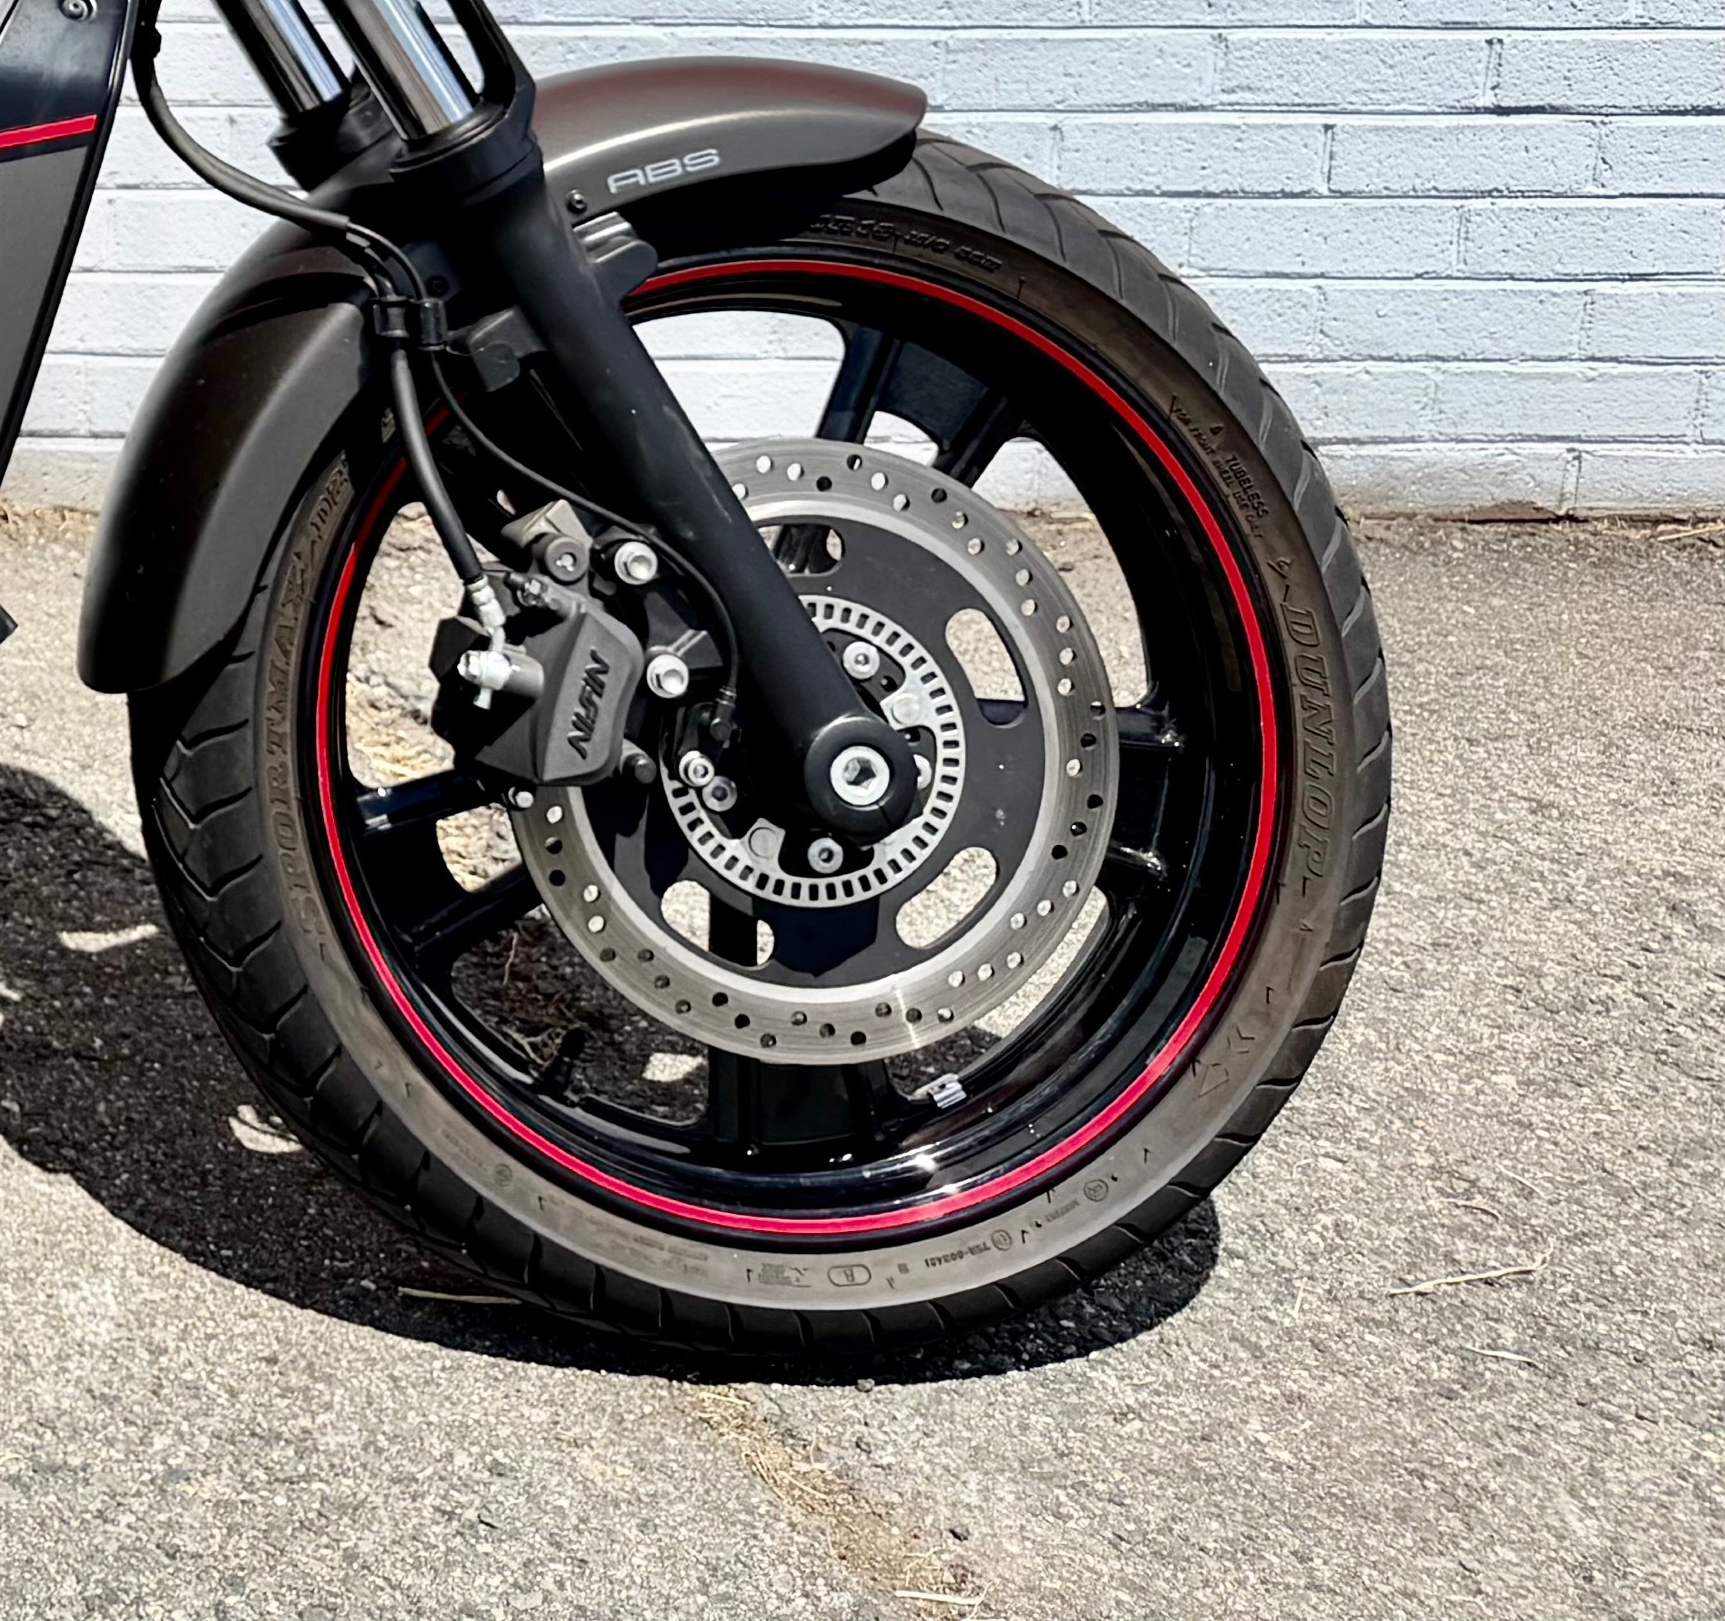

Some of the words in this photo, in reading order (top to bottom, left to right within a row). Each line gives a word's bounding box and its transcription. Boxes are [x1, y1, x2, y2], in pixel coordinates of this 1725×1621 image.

[606, 147, 721, 195] ABS
[1224, 454, 1270, 519] TUBELESS
[264, 560, 327, 940] SPORTMAX
[1280, 604, 1336, 879] DUNLOP
